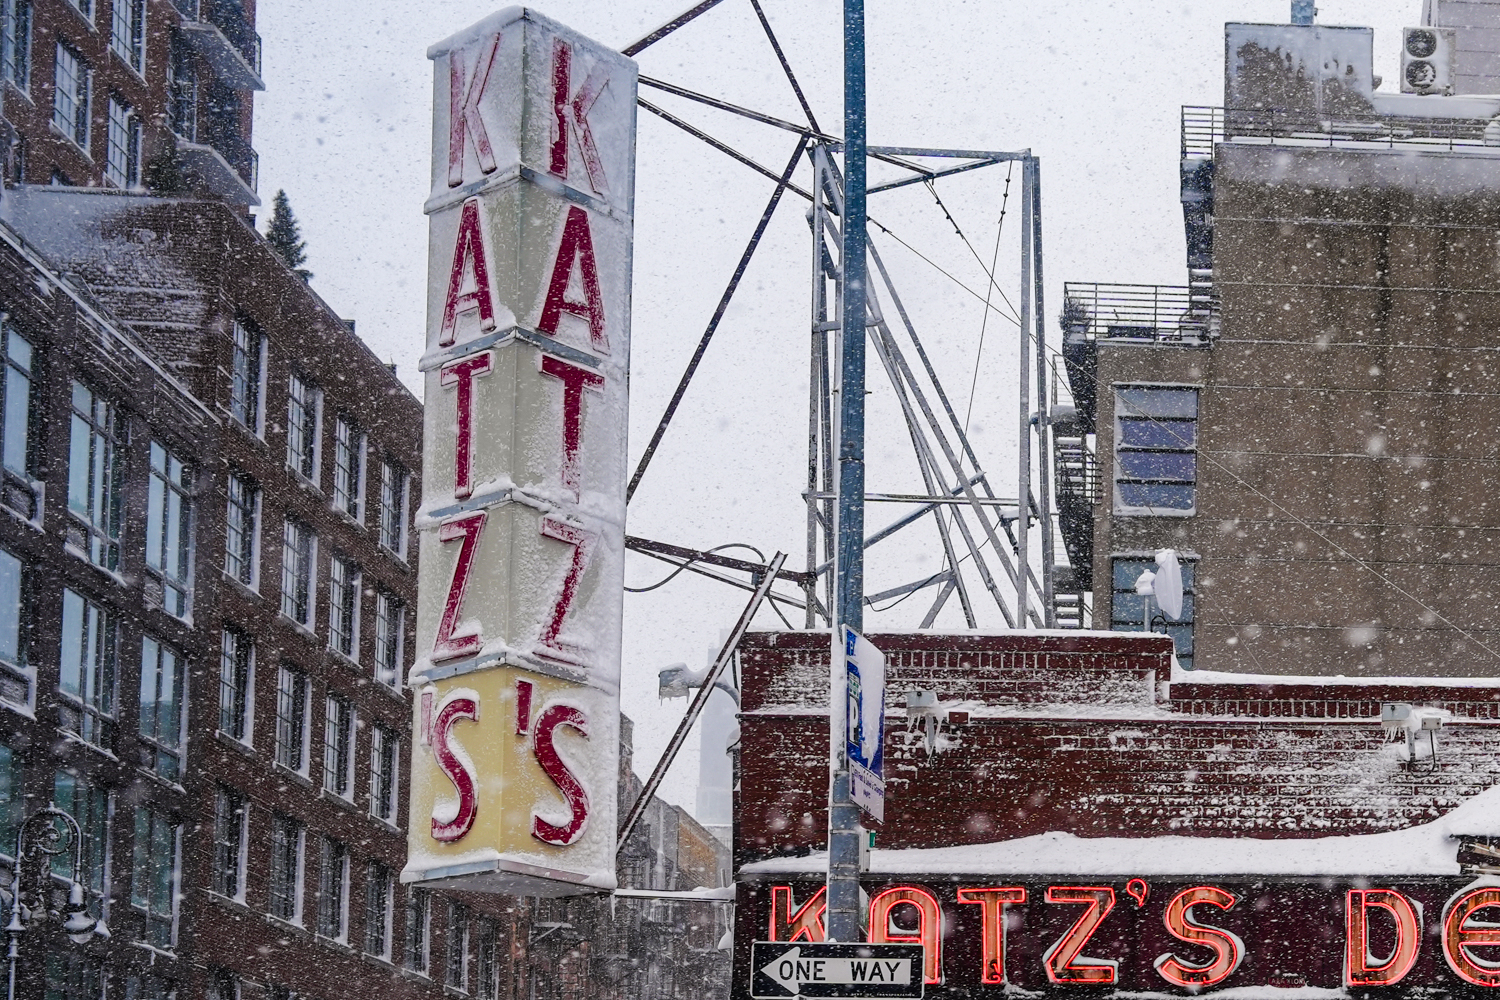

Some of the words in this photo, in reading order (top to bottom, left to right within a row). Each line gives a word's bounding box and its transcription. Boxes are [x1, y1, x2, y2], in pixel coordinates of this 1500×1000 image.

[420, 32, 500, 844] KATZ'S
[515, 36, 610, 848] KATZ'S
[769, 878, 1244, 989] KATZ'S
[779, 960, 826, 981] ONE
[850, 961, 901, 982] WAY
